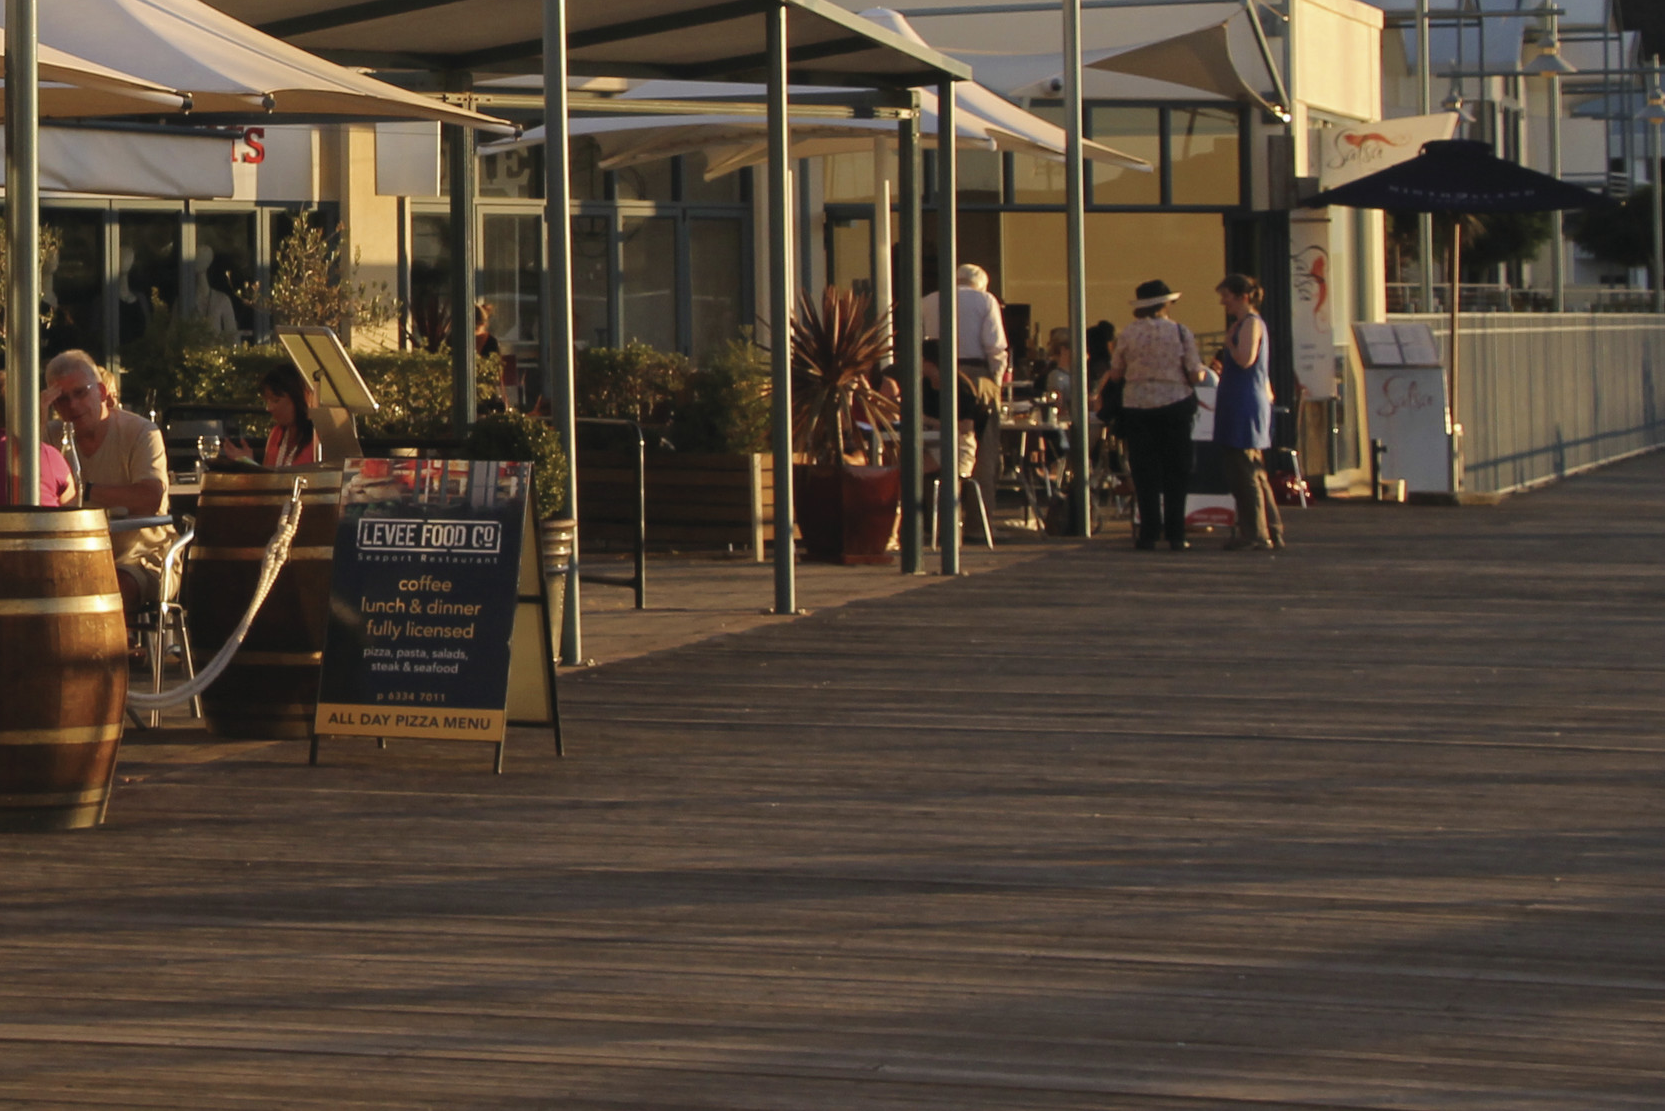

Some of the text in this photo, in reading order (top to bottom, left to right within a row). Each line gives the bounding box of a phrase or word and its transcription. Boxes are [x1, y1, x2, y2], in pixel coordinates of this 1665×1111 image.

[362, 523, 417, 546] LEVEE
[421, 524, 467, 547] FOOD
[357, 553, 498, 564] Seaport Restaurant
[398, 575, 452, 592] coffee
[361, 596, 482, 616] lunch & dinner
[366, 619, 475, 641] fully licensed
[363, 646, 469, 661] pizza, pasta, salads,
[371, 661, 459, 674] steak & seafood
[328, 712, 491, 730] ALL DAY PIZZA MENU
